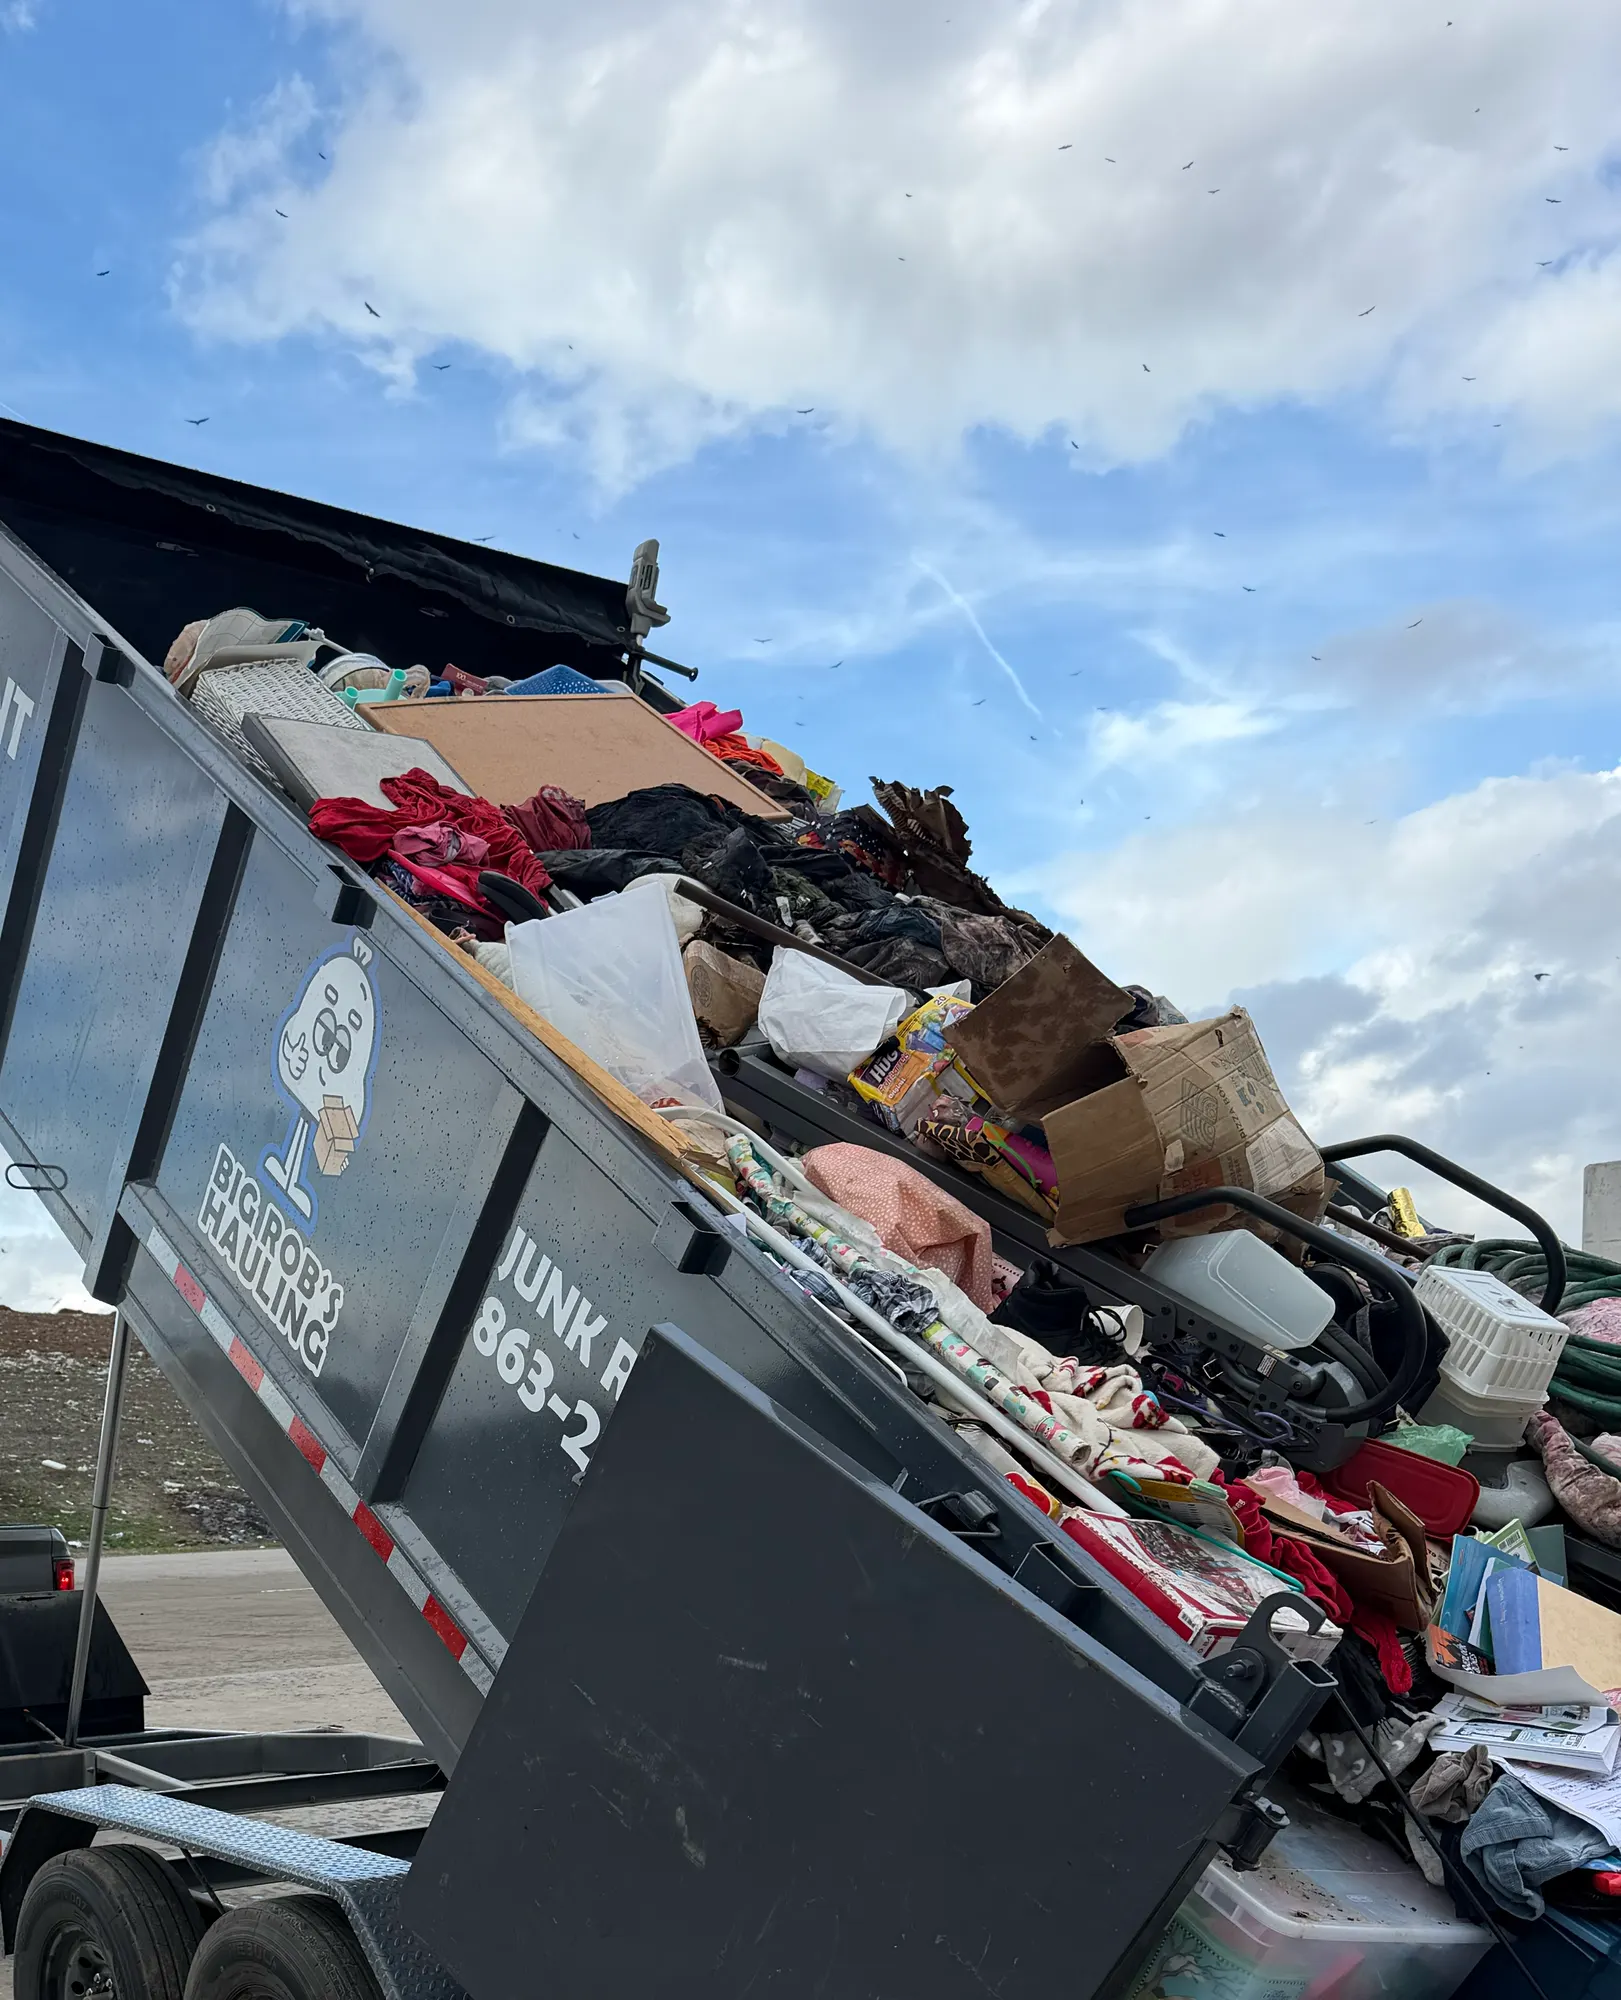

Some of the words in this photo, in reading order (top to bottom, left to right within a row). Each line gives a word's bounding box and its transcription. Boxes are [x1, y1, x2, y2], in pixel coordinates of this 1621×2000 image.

[933, 995, 947, 1006] 20
[1215, 1085, 1230, 1105] BOX
[1229, 1108, 1247, 1139] PIZZA
[199, 1193, 327, 1374] HAULING
[211, 1146, 260, 1224] BIG
[262, 1203, 342, 1326] ROB'S
[498, 1226, 608, 1368] JUNK
[600, 1337, 638, 1401] R
[473, 1297, 601, 1482] 863-2
